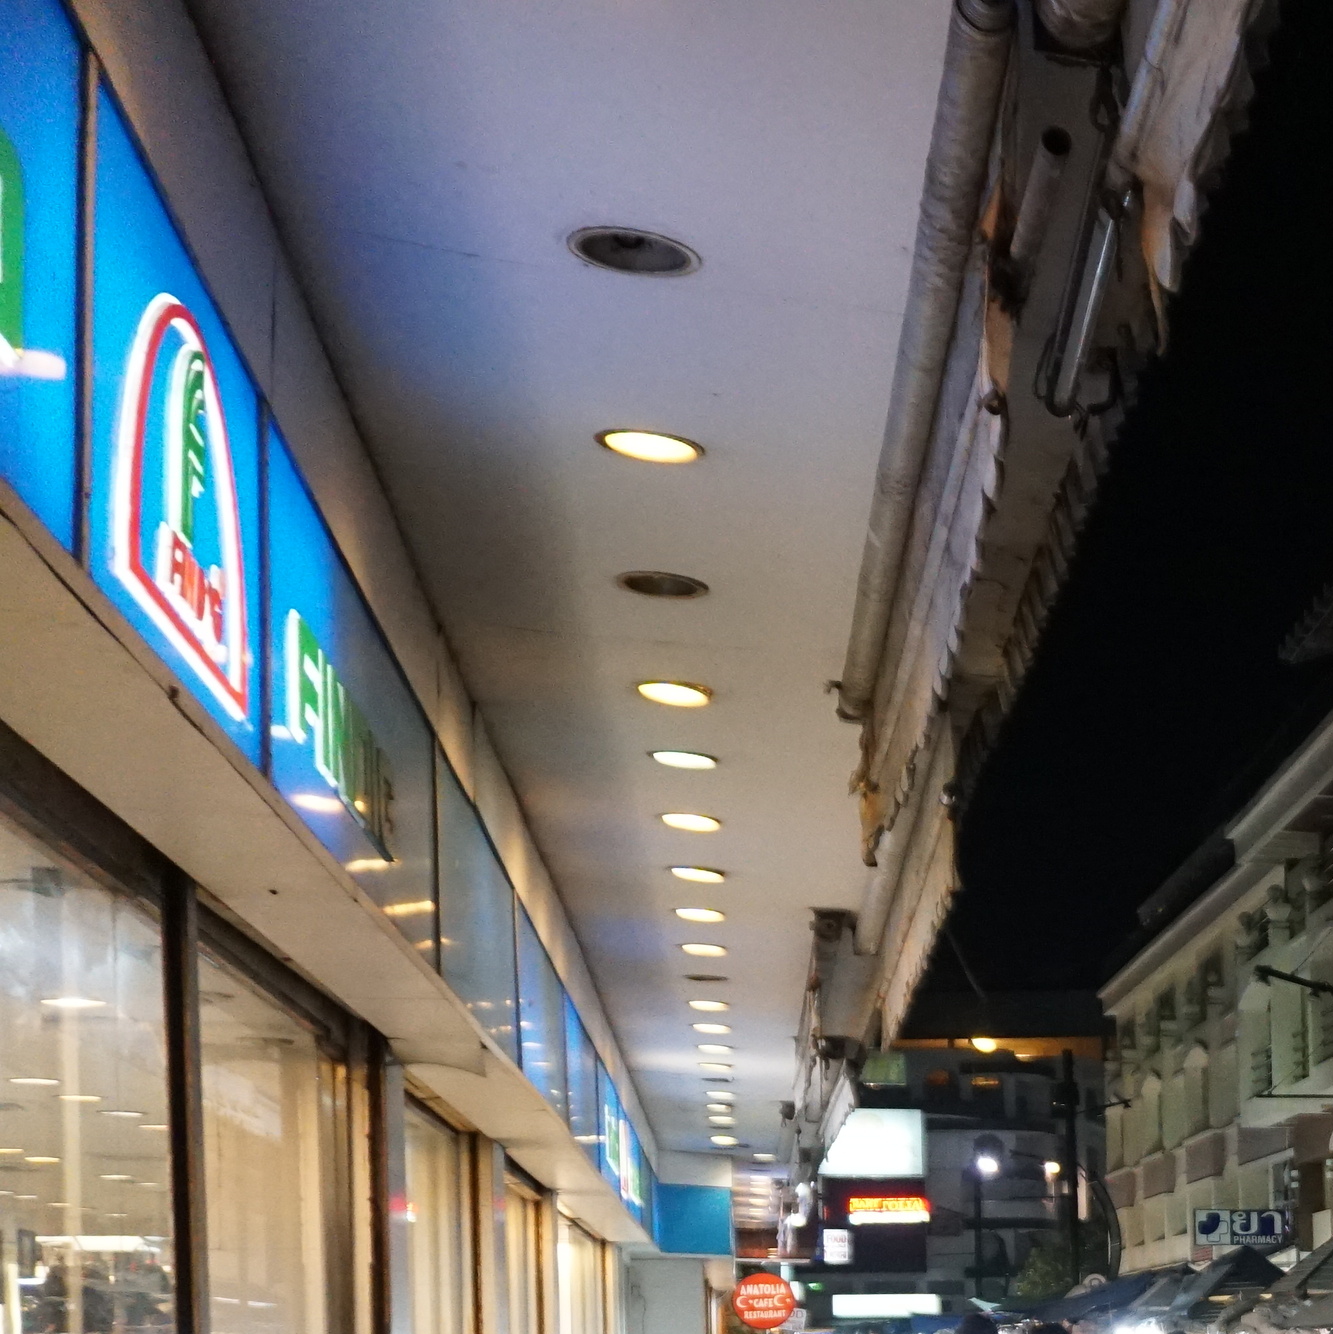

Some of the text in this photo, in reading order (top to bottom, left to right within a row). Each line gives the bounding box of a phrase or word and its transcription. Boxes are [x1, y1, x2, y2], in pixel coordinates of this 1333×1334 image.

[1231, 1211, 1282, 1234] ยา
[1233, 1235, 1282, 1244] PHARMACY
[740, 1283, 787, 1295] ANATOLIA
[753, 1298, 774, 1308] CAFE
[744, 1310, 786, 1319] RESTAURANT
